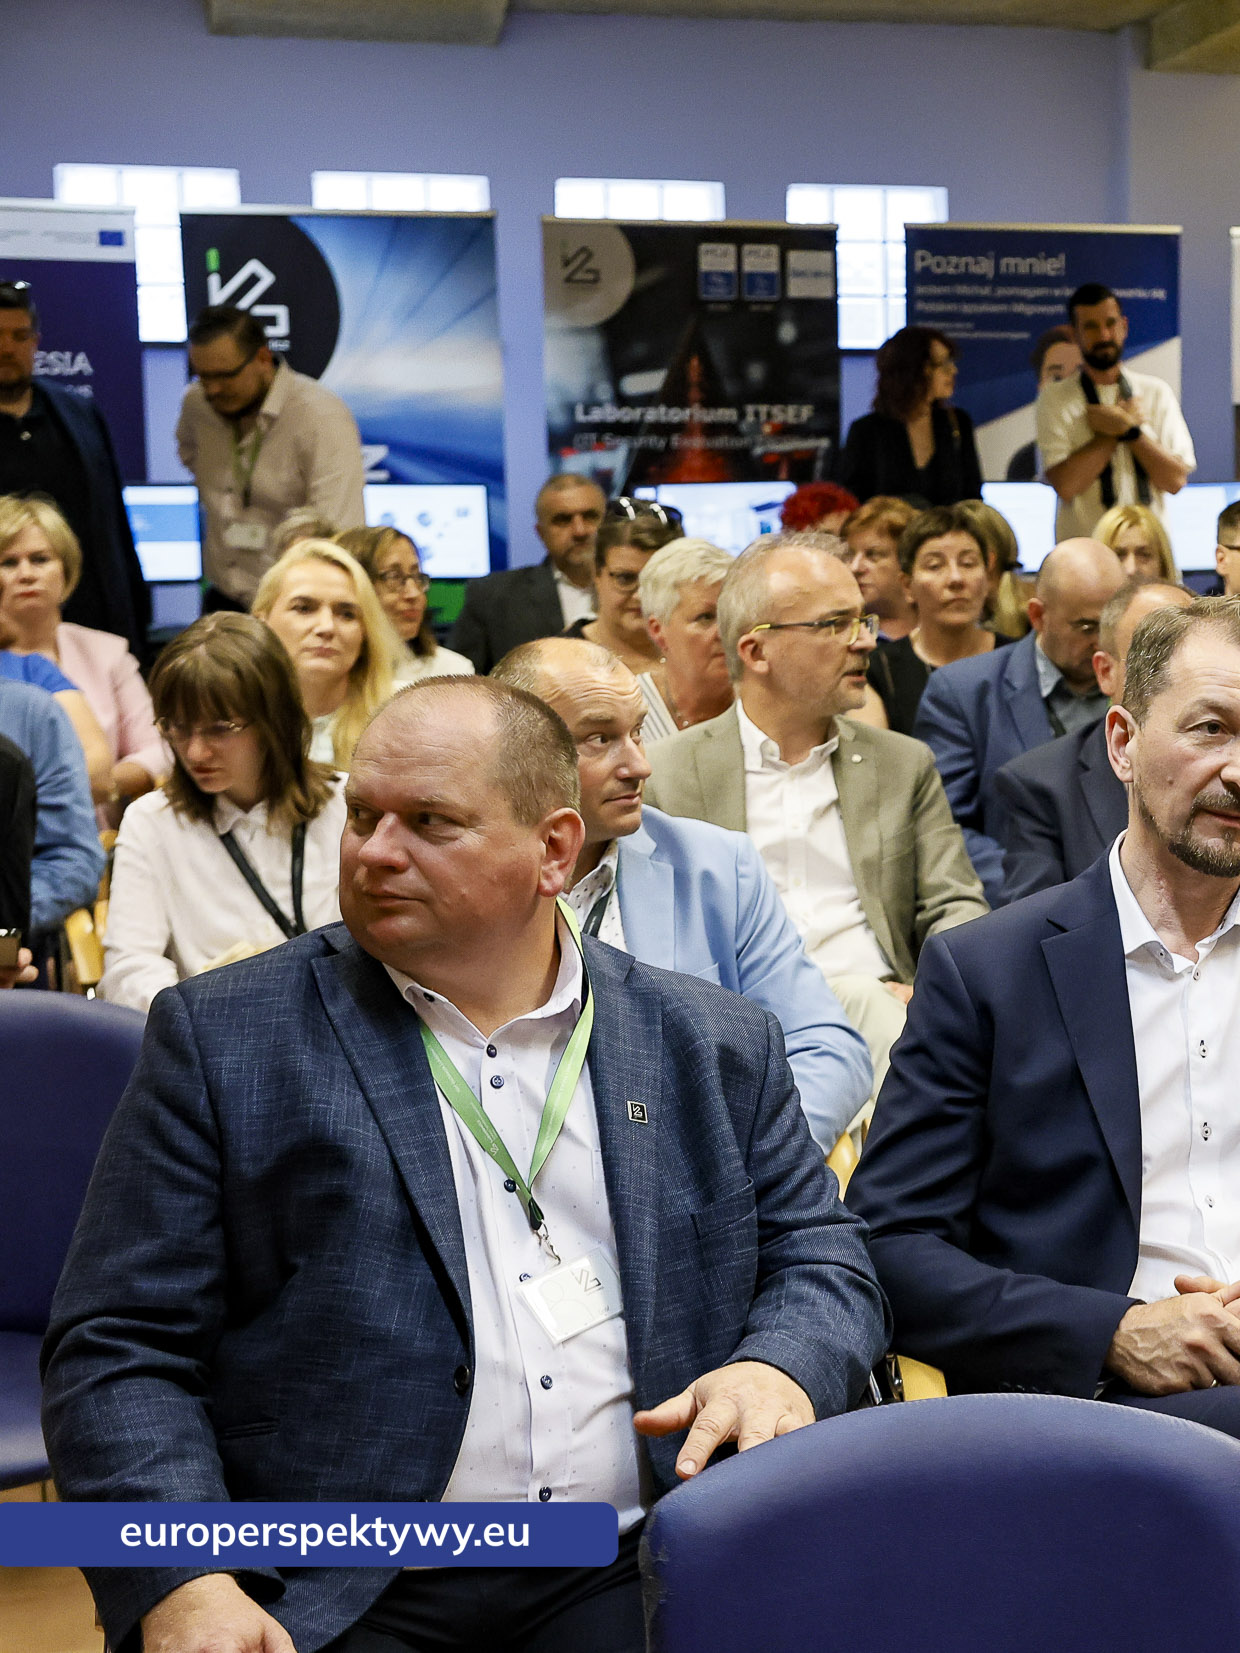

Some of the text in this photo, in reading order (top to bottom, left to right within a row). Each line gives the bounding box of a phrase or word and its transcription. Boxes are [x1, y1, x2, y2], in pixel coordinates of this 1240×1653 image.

[914, 249, 1066, 280] Poznaj mnie!
[575, 401, 738, 423] Laboratorium
